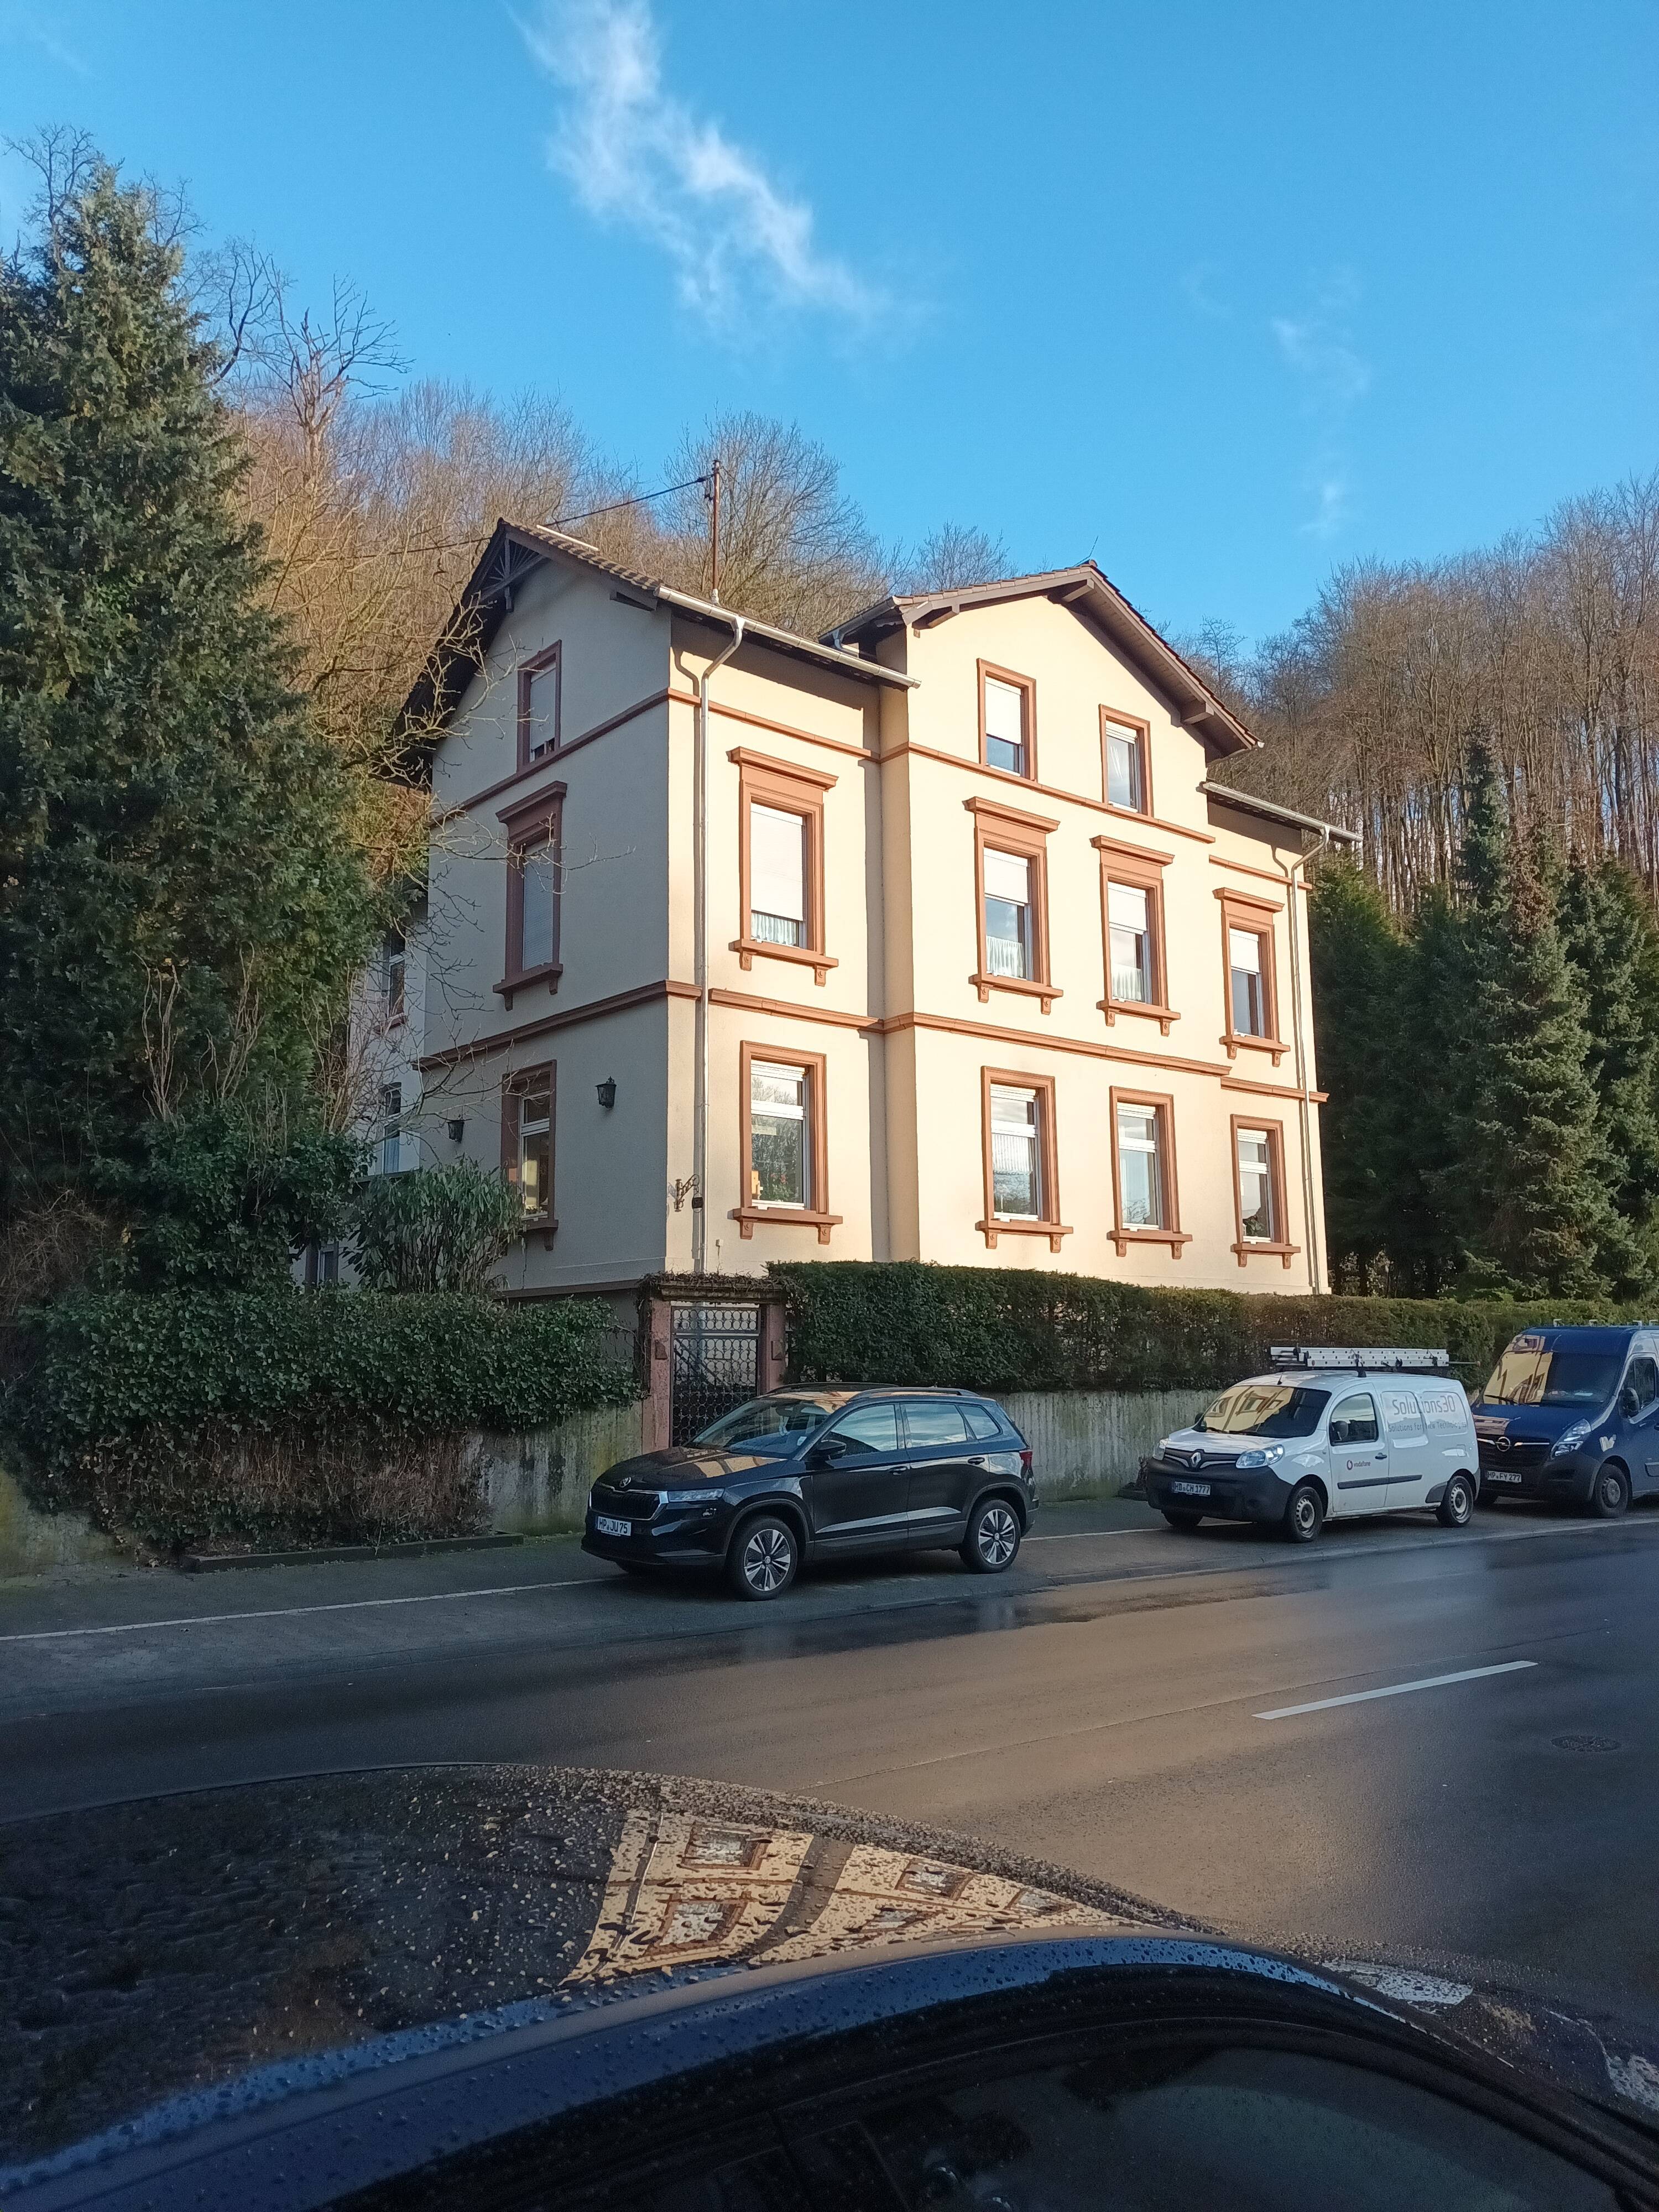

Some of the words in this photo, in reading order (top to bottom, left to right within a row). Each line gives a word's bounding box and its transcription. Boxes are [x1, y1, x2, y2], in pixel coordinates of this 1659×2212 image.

[1389, 1423, 1412, 1432] Solutions
[1186, 1484, 1194, 1493] CH
[599, 1517, 607, 1530] HP
[611, 1521, 618, 1532] JU
[620, 1522, 628, 1534] 75
